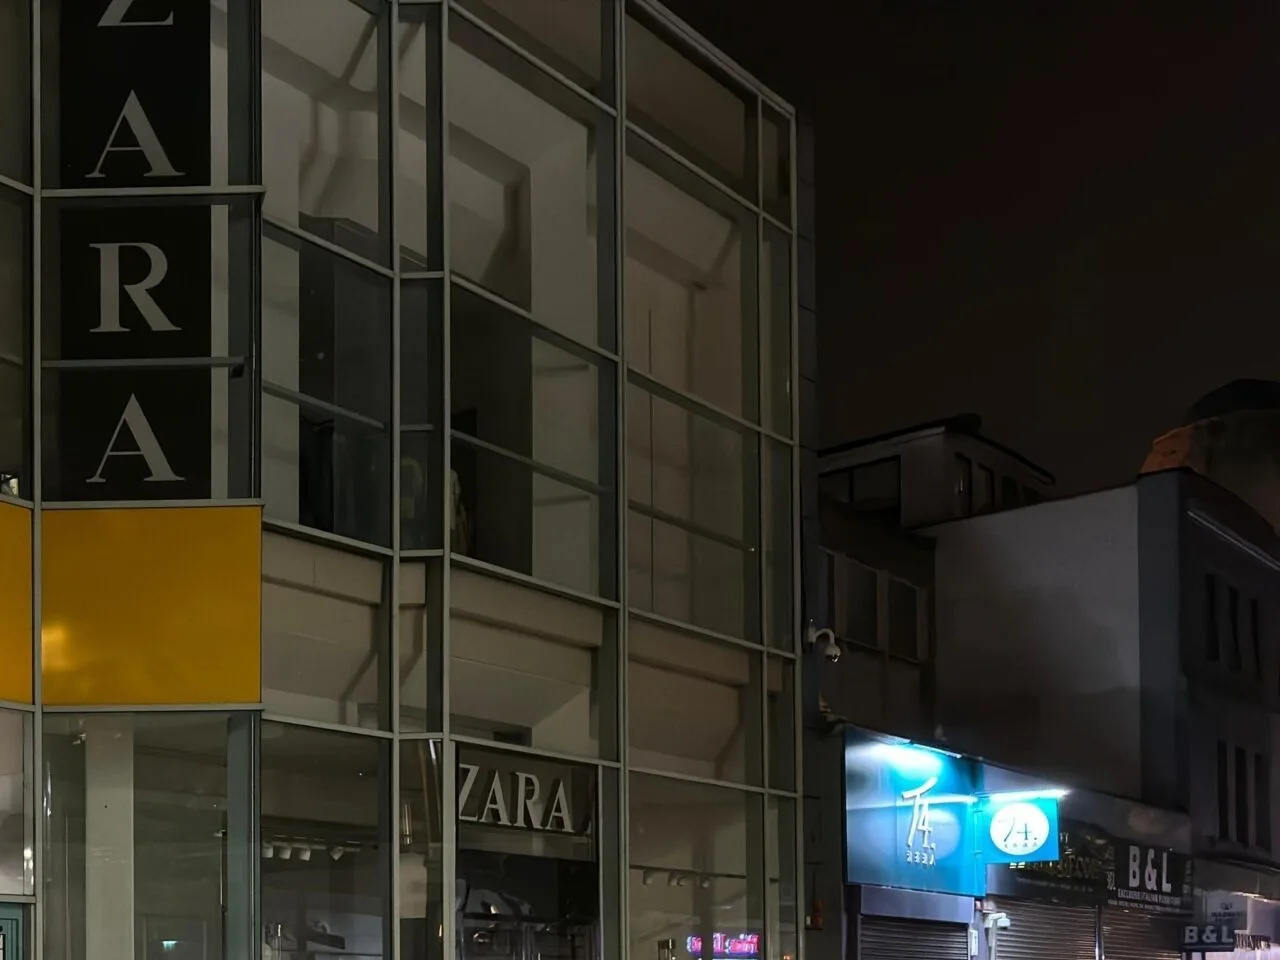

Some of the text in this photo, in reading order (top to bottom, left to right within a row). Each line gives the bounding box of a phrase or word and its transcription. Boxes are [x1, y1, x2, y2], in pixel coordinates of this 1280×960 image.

[458, 762, 576, 833] ZARA
[1128, 845, 1141, 888] B
[1144, 848, 1158, 891] &
[1162, 851, 1172, 893] L
[1184, 925, 1199, 944] B
[1202, 925, 1218, 944] &
[1221, 925, 1234, 941] L
